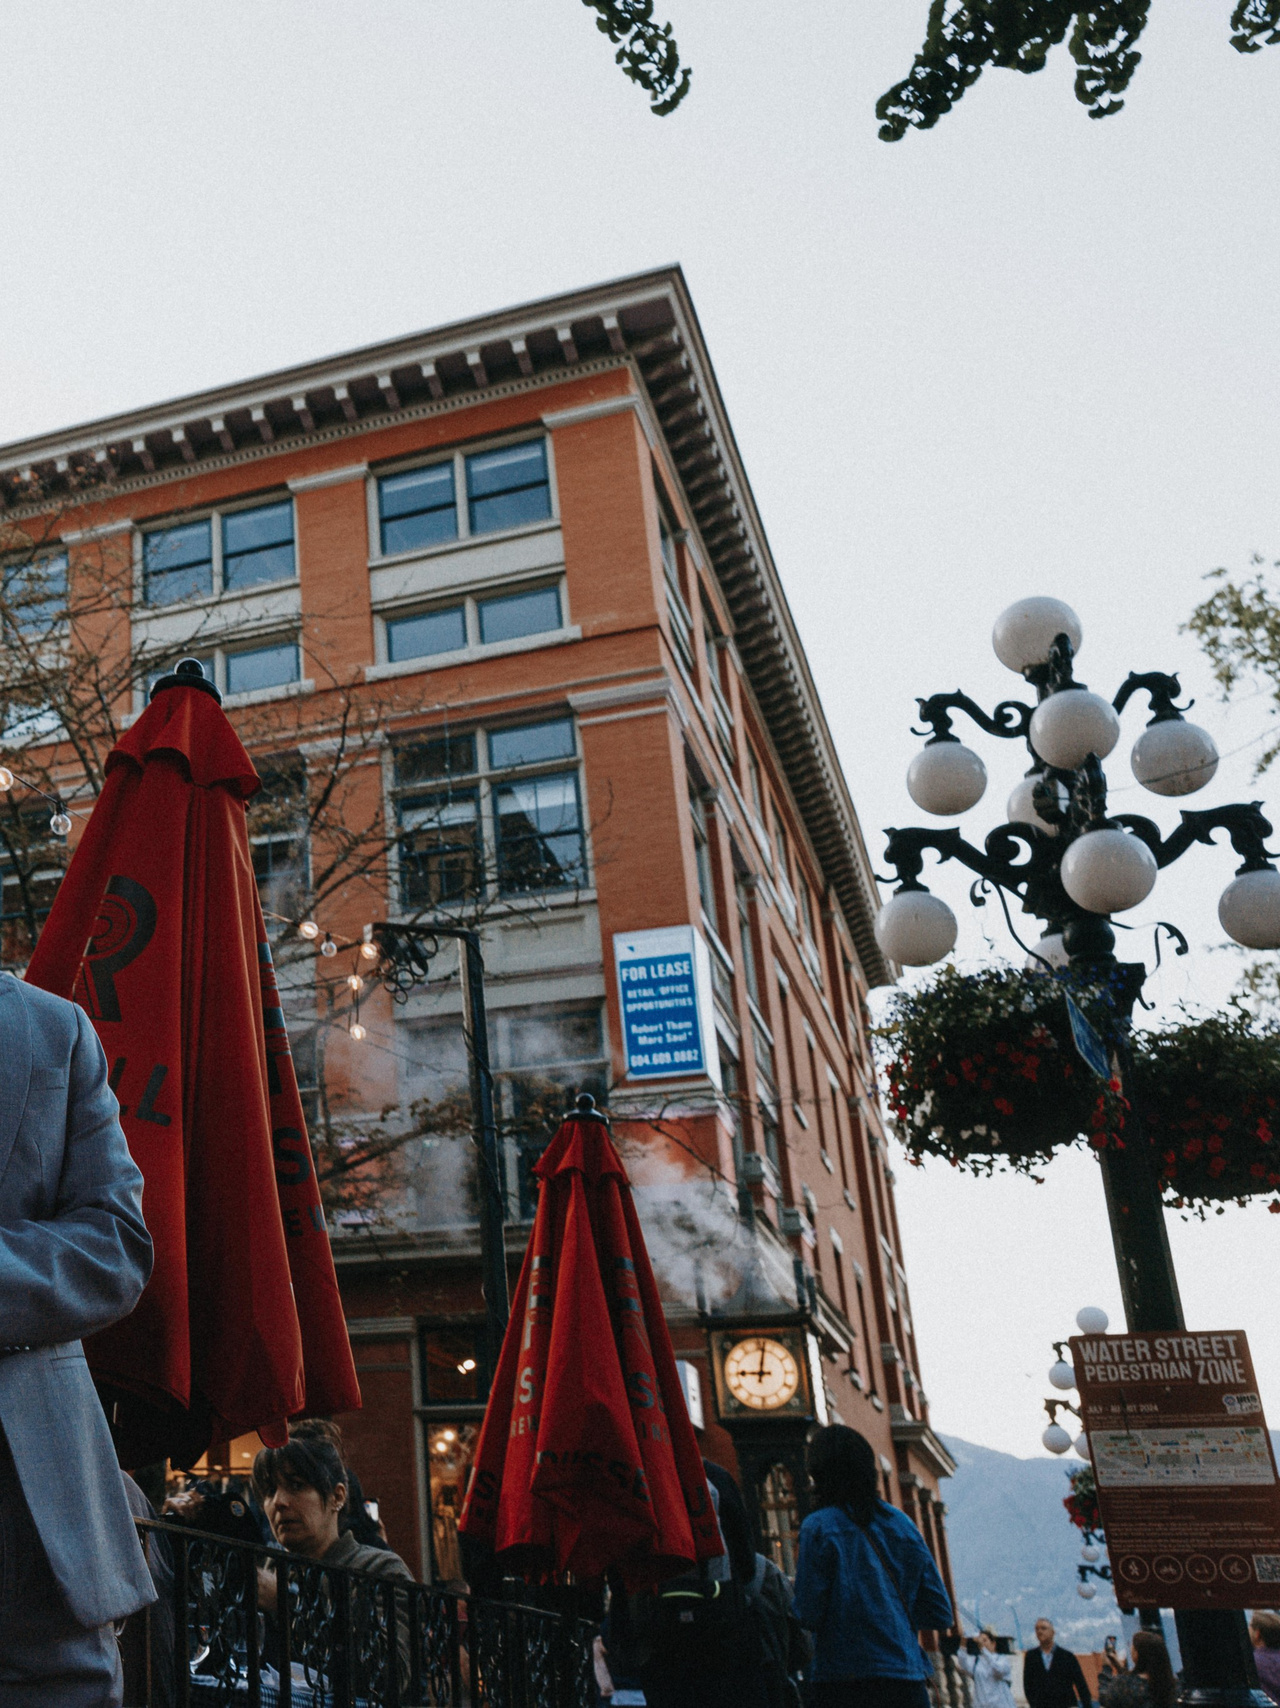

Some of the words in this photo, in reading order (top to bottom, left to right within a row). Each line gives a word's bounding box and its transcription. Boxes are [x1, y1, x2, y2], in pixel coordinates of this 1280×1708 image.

[622, 966, 647, 982] FOR
[650, 960, 691, 979] LEASE
[626, 997, 693, 1013] OPPORTUNITIES
[1078, 1338, 1151, 1363] WATER
[1154, 1335, 1237, 1360] STREET
[1084, 1361, 1193, 1382] PEDESTRIAN
[1195, 1359, 1247, 1385] ZONE
